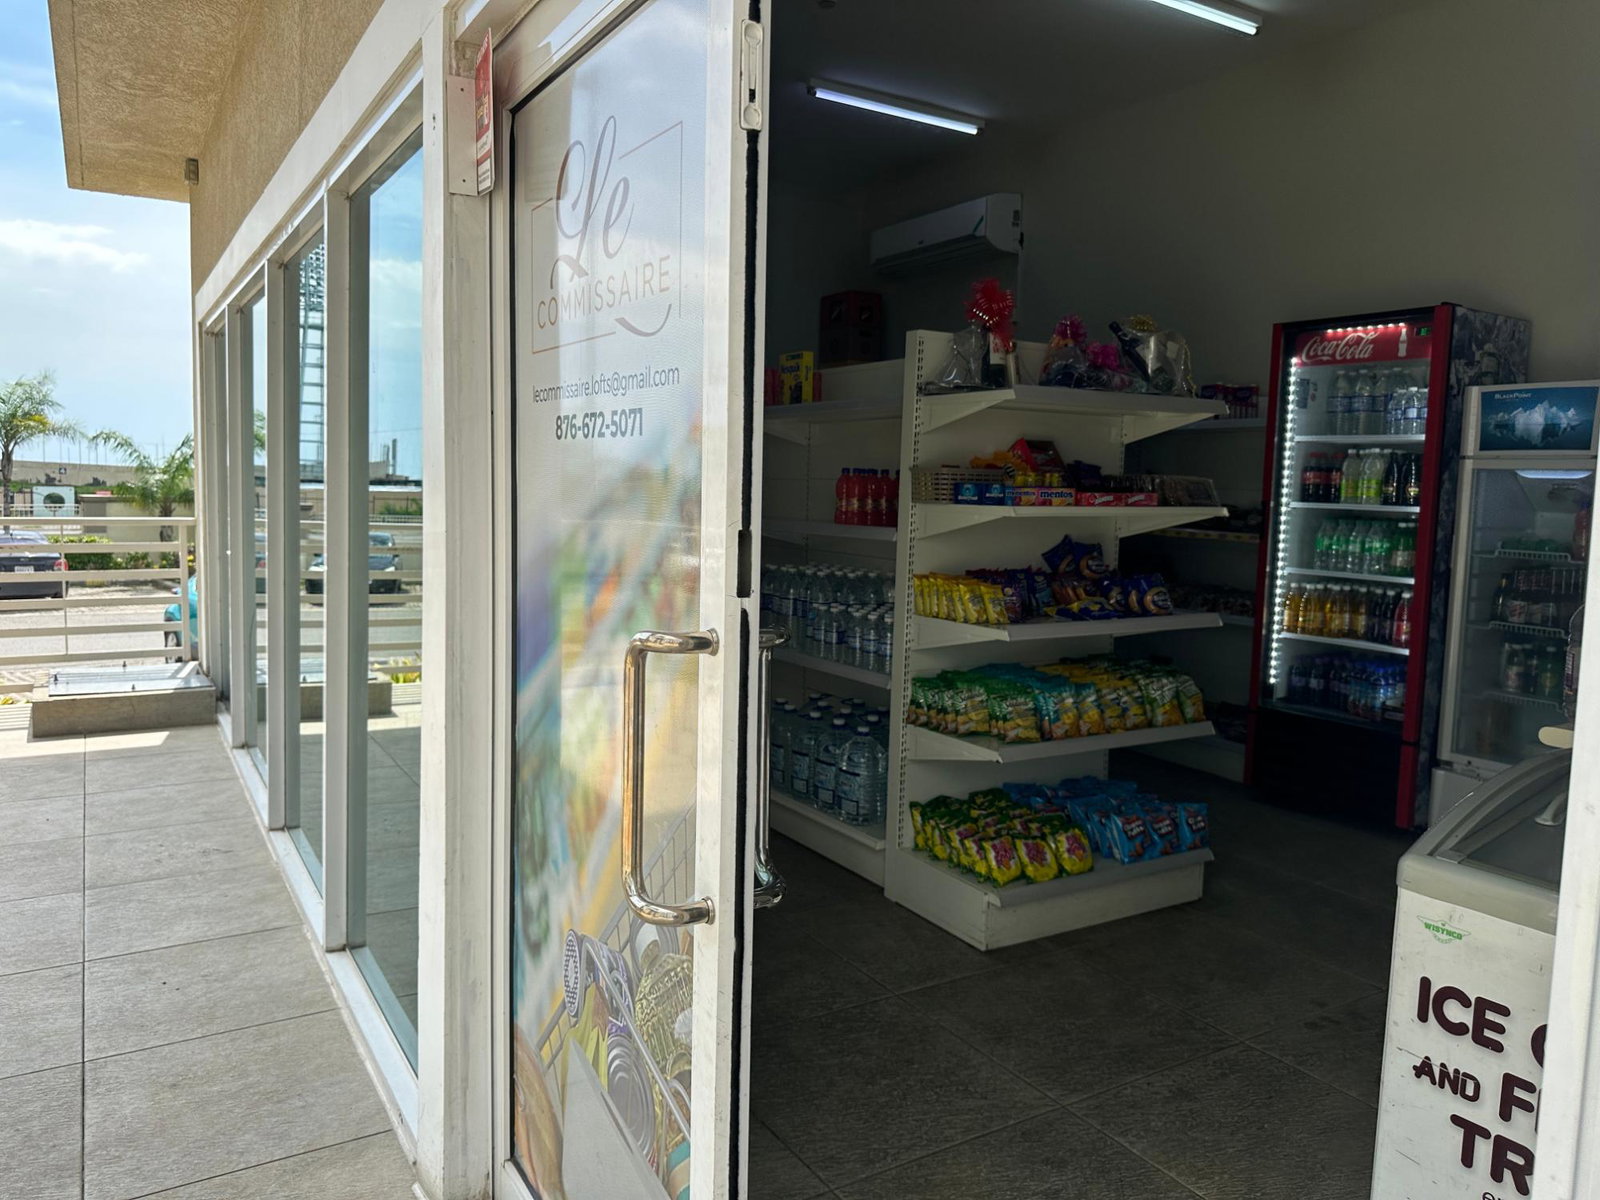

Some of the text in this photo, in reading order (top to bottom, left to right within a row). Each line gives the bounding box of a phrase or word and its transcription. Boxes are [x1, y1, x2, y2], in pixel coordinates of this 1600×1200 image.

[551, 115, 635, 289] Le
[537, 255, 672, 329] COMMISSAIRE
[1302, 332, 1380, 363] Coca-Cola
[532, 365, 680, 403] lecommissaire.lofts@gmail.com
[555, 407, 644, 440] 876-672-5071
[1424, 922, 1463, 940] WISYNCO
[1416, 976, 1511, 1053] ICE
[1412, 1056, 1481, 1102] AND
[1498, 1072, 1543, 1134] F
